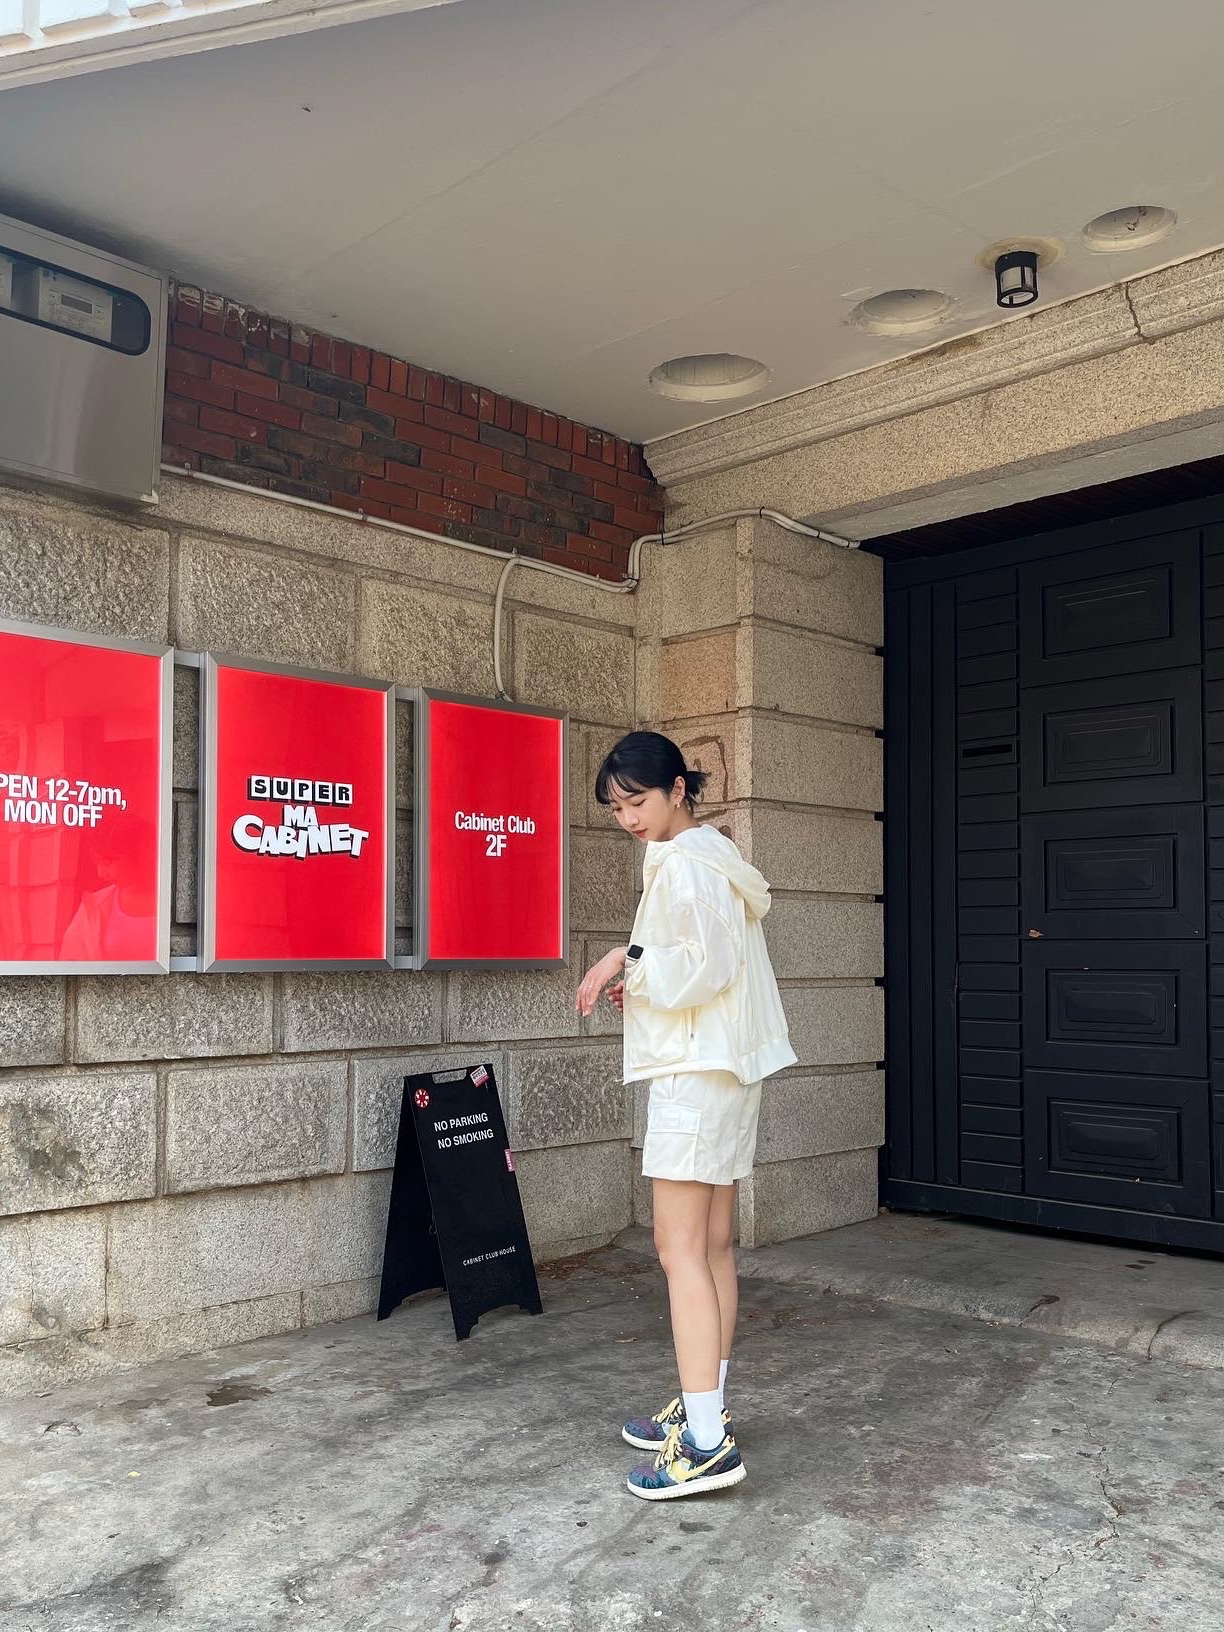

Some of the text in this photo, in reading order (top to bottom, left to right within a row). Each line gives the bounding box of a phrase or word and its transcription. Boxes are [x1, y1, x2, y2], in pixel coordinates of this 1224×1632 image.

[45, 778, 127, 810] 12-7pm,
[250, 776, 353, 804] SUPER
[4, 799, 103, 828] MON OFF
[283, 804, 319, 828] MA
[454, 811, 536, 835] Cabinet Club
[232, 814, 370, 859] CABINET
[485, 834, 507, 857] 2F
[433, 1112, 489, 1132] NO PARKING
[437, 1128, 495, 1149] NO SMOKING
[462, 1245, 516, 1266] CABINET CLUB HOUSE
